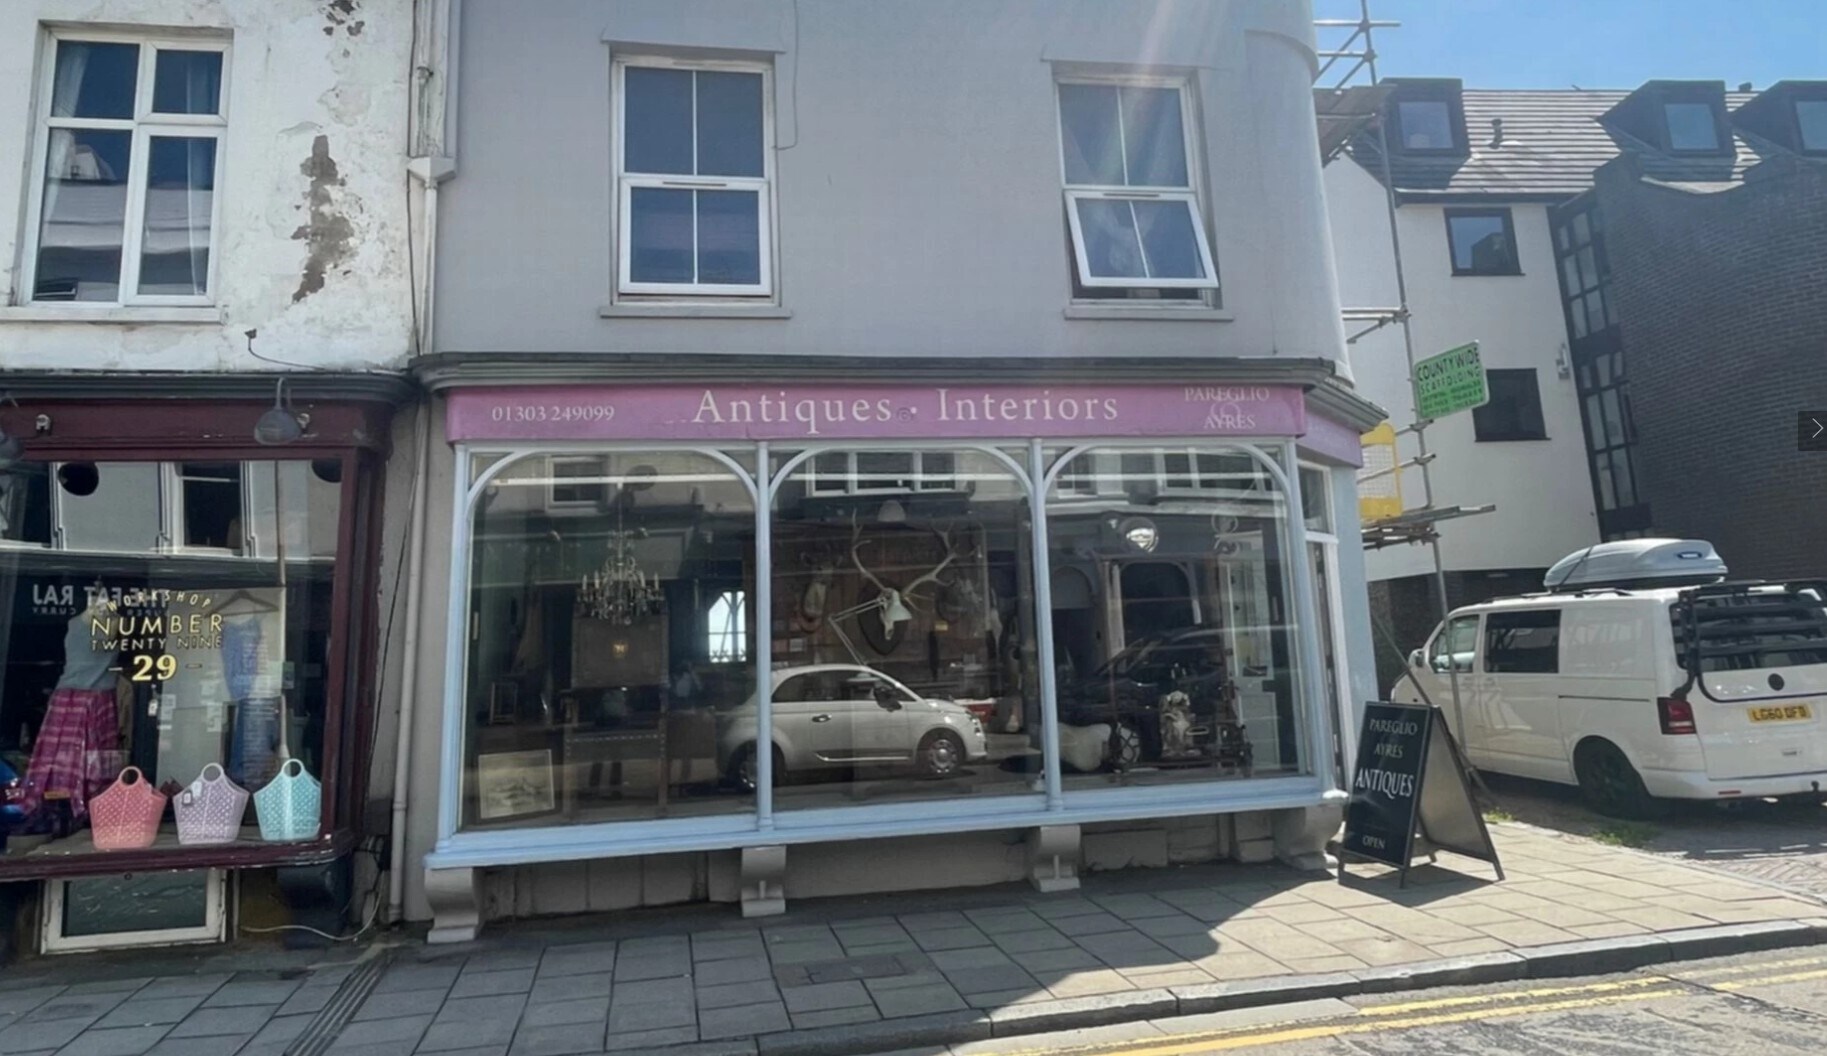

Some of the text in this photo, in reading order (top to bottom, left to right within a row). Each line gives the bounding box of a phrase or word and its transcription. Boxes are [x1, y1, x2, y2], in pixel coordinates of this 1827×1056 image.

[1184, 386, 1270, 401] PAREGLIO
[492, 406, 615, 421] 01303 249099
[692, 388, 1118, 434] Antiques Interiors
[1203, 415, 1256, 429] AYRES
[107, 589, 211, 612] WORKSHOP
[92, 614, 222, 636] NUMBER
[91, 636, 222, 651] TWENTY NINE
[132, 655, 177, 681] 29
[1369, 719, 1418, 736] PAREGLIO
[1374, 742, 1403, 758] AYRES
[1355, 767, 1414, 799] ANTIQUES
[1362, 835, 1386, 849] OPEN
